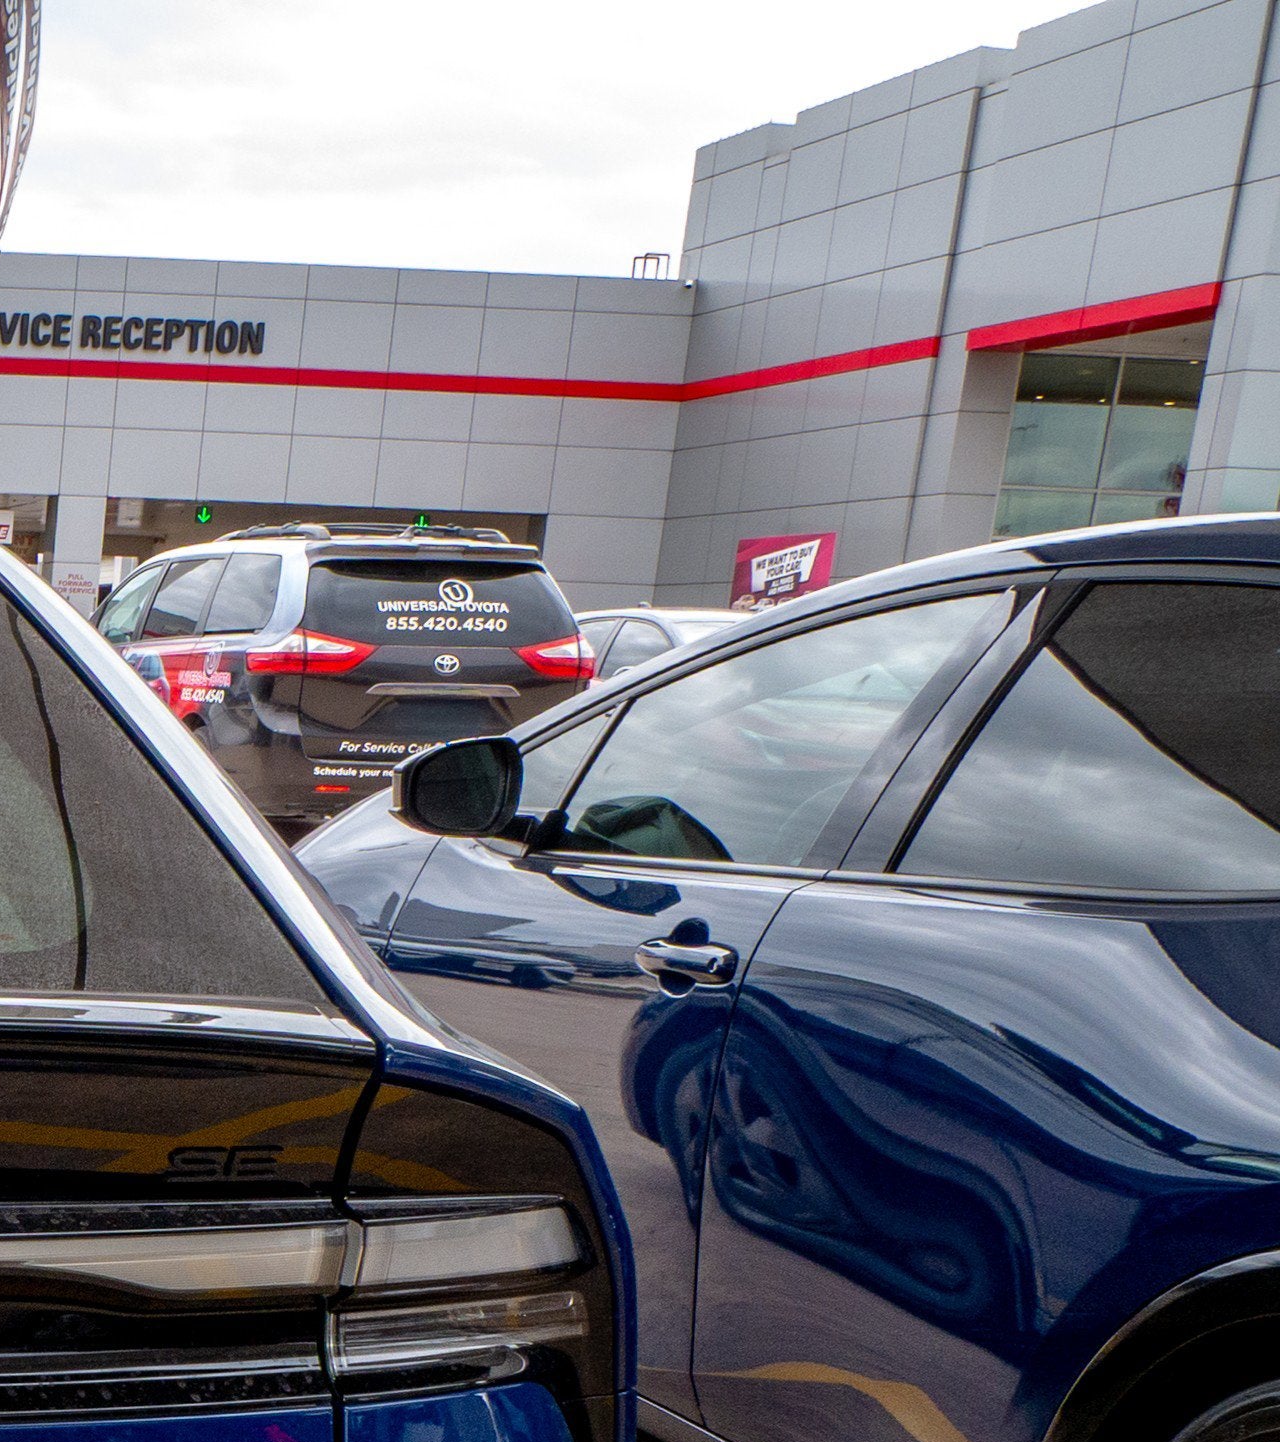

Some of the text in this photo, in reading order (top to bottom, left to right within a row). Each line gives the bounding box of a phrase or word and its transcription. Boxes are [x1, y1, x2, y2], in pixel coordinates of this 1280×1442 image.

[79, 314, 265, 355] RECEPTION
[756, 545, 814, 570] WE WANT TO BUY
[766, 565, 784, 578] YOUR
[58, 580, 93, 588] FORWARD
[69, 587, 96, 595] SERVICE
[377, 601, 510, 614] UNIVERSAL TOYOTA
[385, 616, 508, 632] 855.420.4540
[339, 741, 361, 753] For
[362, 742, 405, 754] Service
[313, 766, 357, 777] Schedule
[359, 769, 381, 779] your
[165, 1145, 285, 1177] SE
